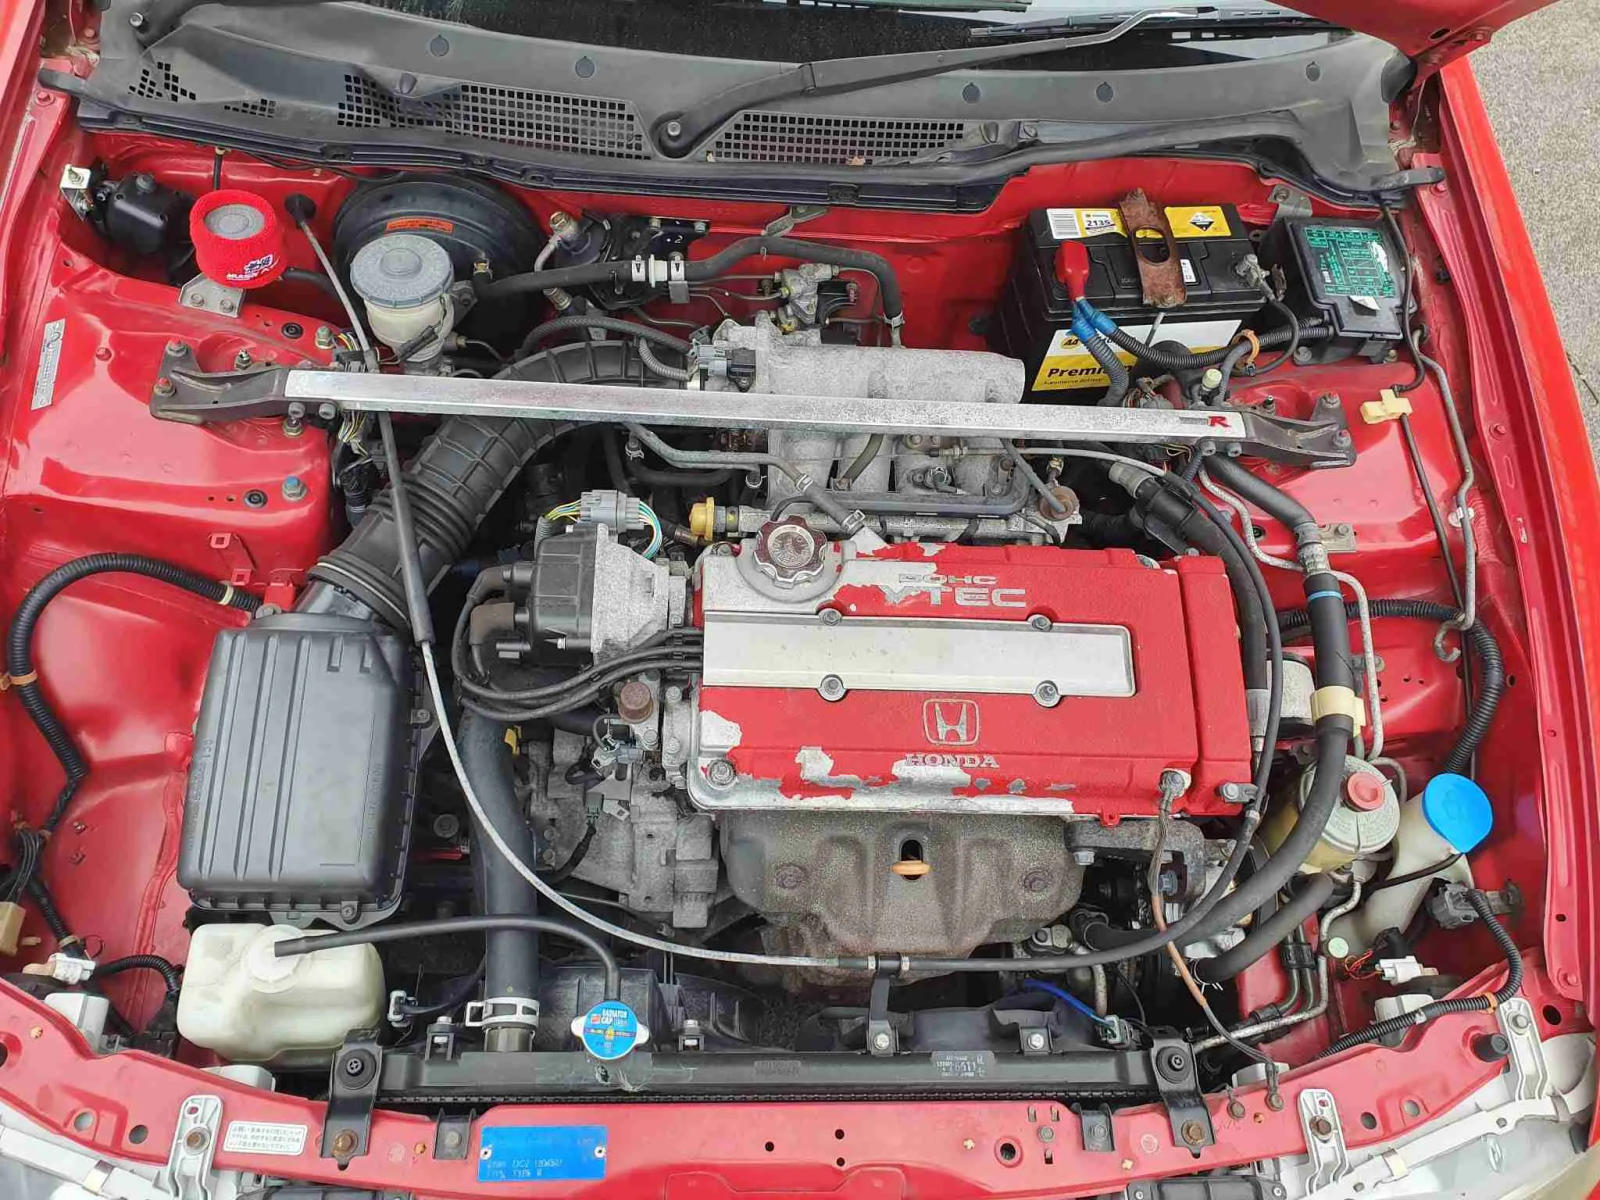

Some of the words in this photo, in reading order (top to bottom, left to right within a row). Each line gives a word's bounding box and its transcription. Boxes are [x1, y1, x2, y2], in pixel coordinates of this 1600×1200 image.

[898, 573, 997, 585] DOHC
[877, 584, 1026, 608] VTEC
[904, 753, 1000, 769] HONDA
